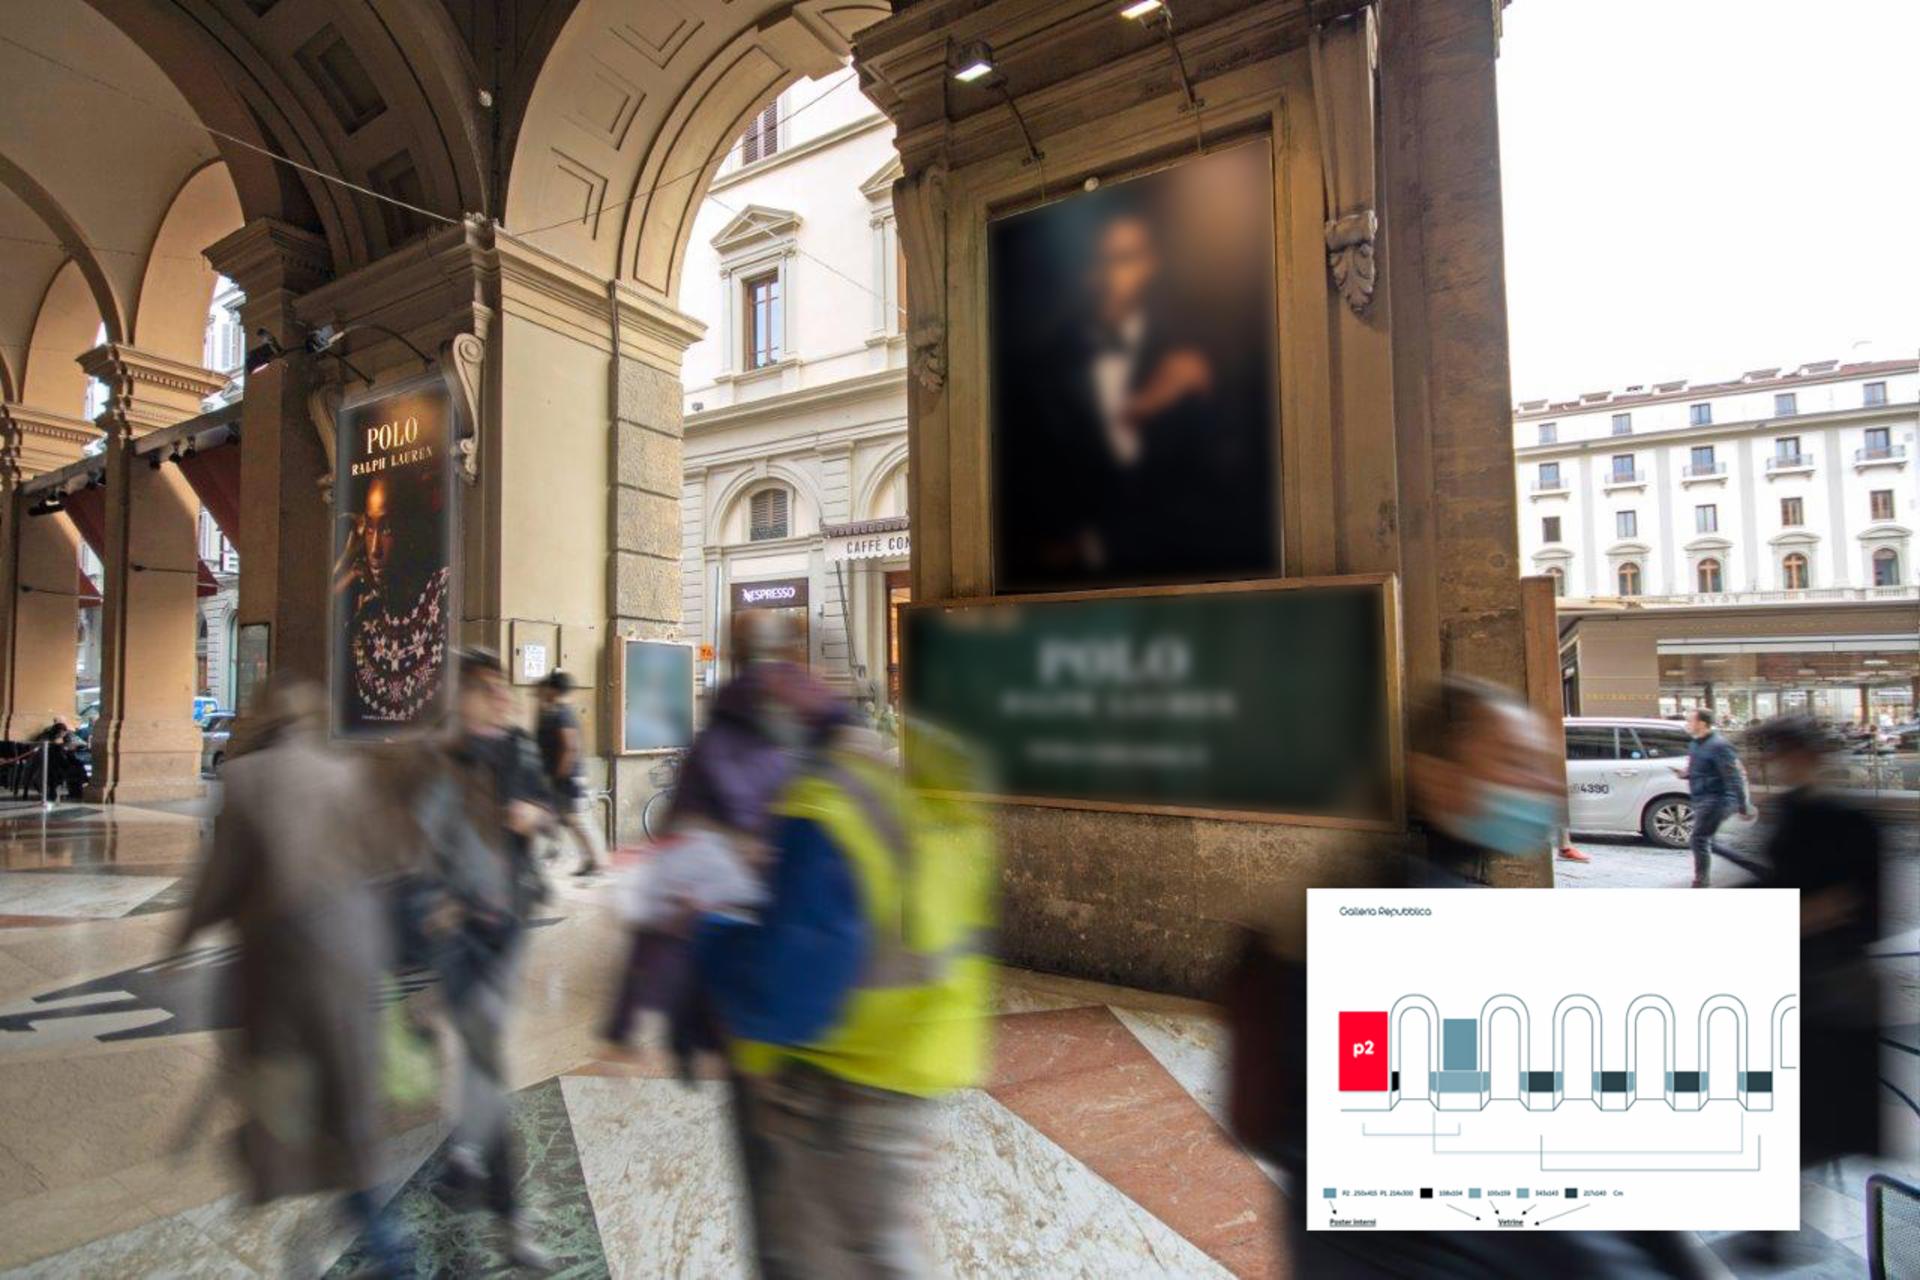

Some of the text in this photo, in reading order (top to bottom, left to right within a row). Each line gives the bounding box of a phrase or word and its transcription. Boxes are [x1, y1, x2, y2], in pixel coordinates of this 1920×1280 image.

[367, 416, 418, 454] POLO
[352, 445, 432, 476] RALPH LAUREN
[847, 539, 882, 554] CAFFÈ
[742, 588, 795, 602] NESPRESSO
[1580, 783, 1609, 794] 4390
